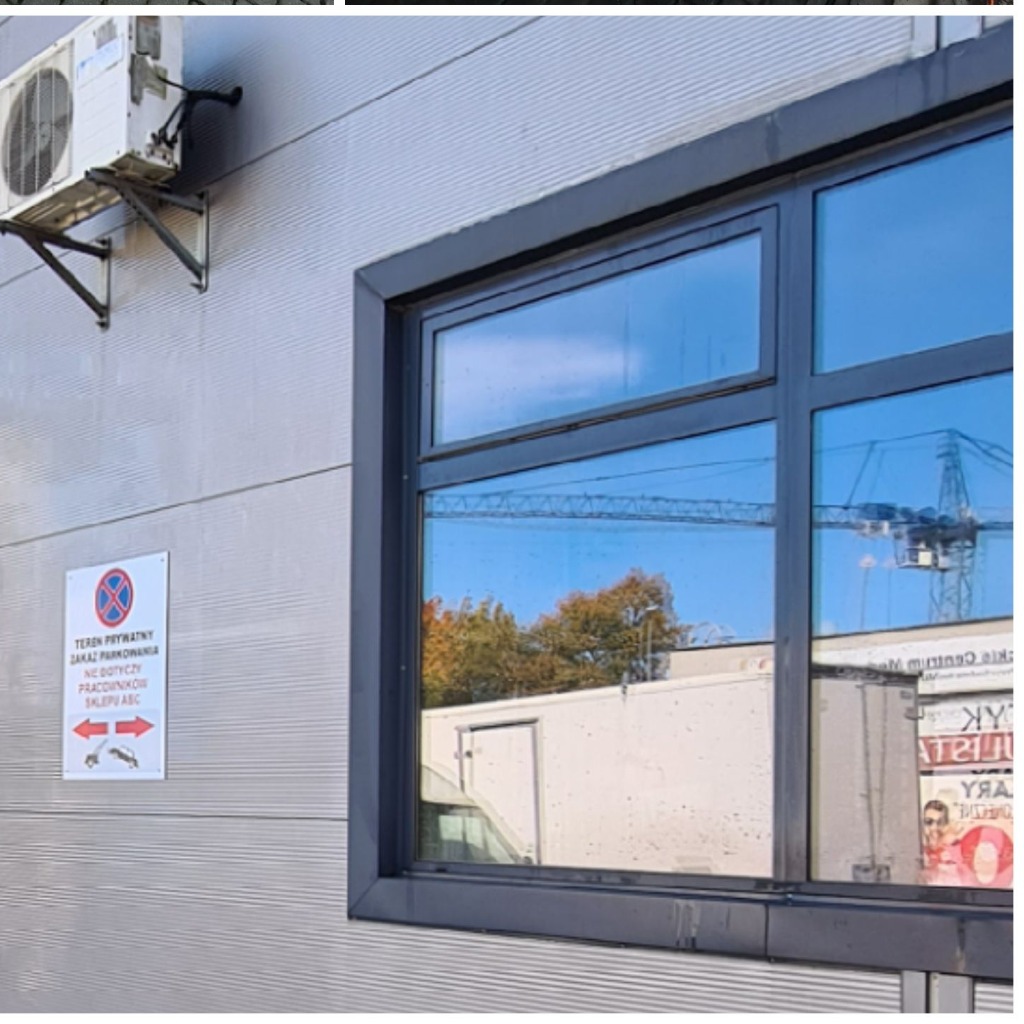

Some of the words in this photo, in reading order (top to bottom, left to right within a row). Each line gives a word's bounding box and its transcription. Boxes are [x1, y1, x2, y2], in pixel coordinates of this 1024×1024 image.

[74, 637, 102, 649] TEREN
[105, 630, 154, 645] PRYWATNY
[70, 652, 97, 665] ZAKAZ
[100, 646, 159, 660] PARKOWANIA
[100, 663, 142, 678] DOTYCZY
[85, 695, 120, 709] SKLEPU
